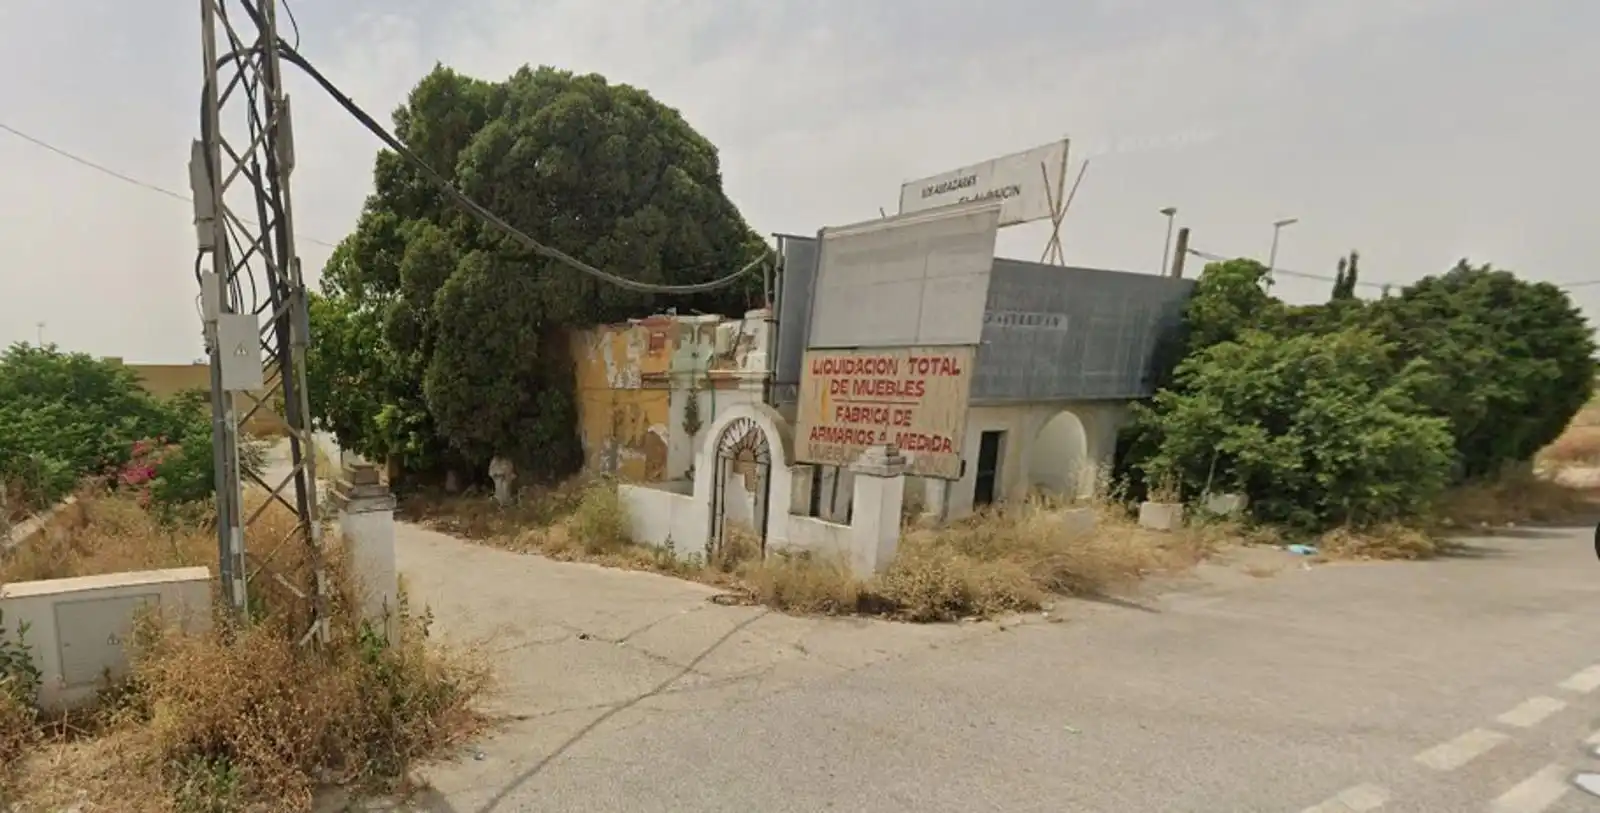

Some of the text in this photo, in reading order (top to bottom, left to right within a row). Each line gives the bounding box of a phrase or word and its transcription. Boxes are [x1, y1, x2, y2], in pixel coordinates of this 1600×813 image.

[812, 357, 961, 376] LIQUIDACION TOTAL
[830, 379, 925, 397] DE MUEBLES
[835, 406, 912, 427] FABRICA DE
[809, 426, 875, 445] ARMARIOS
[895, 431, 953, 453] MEDIDA
